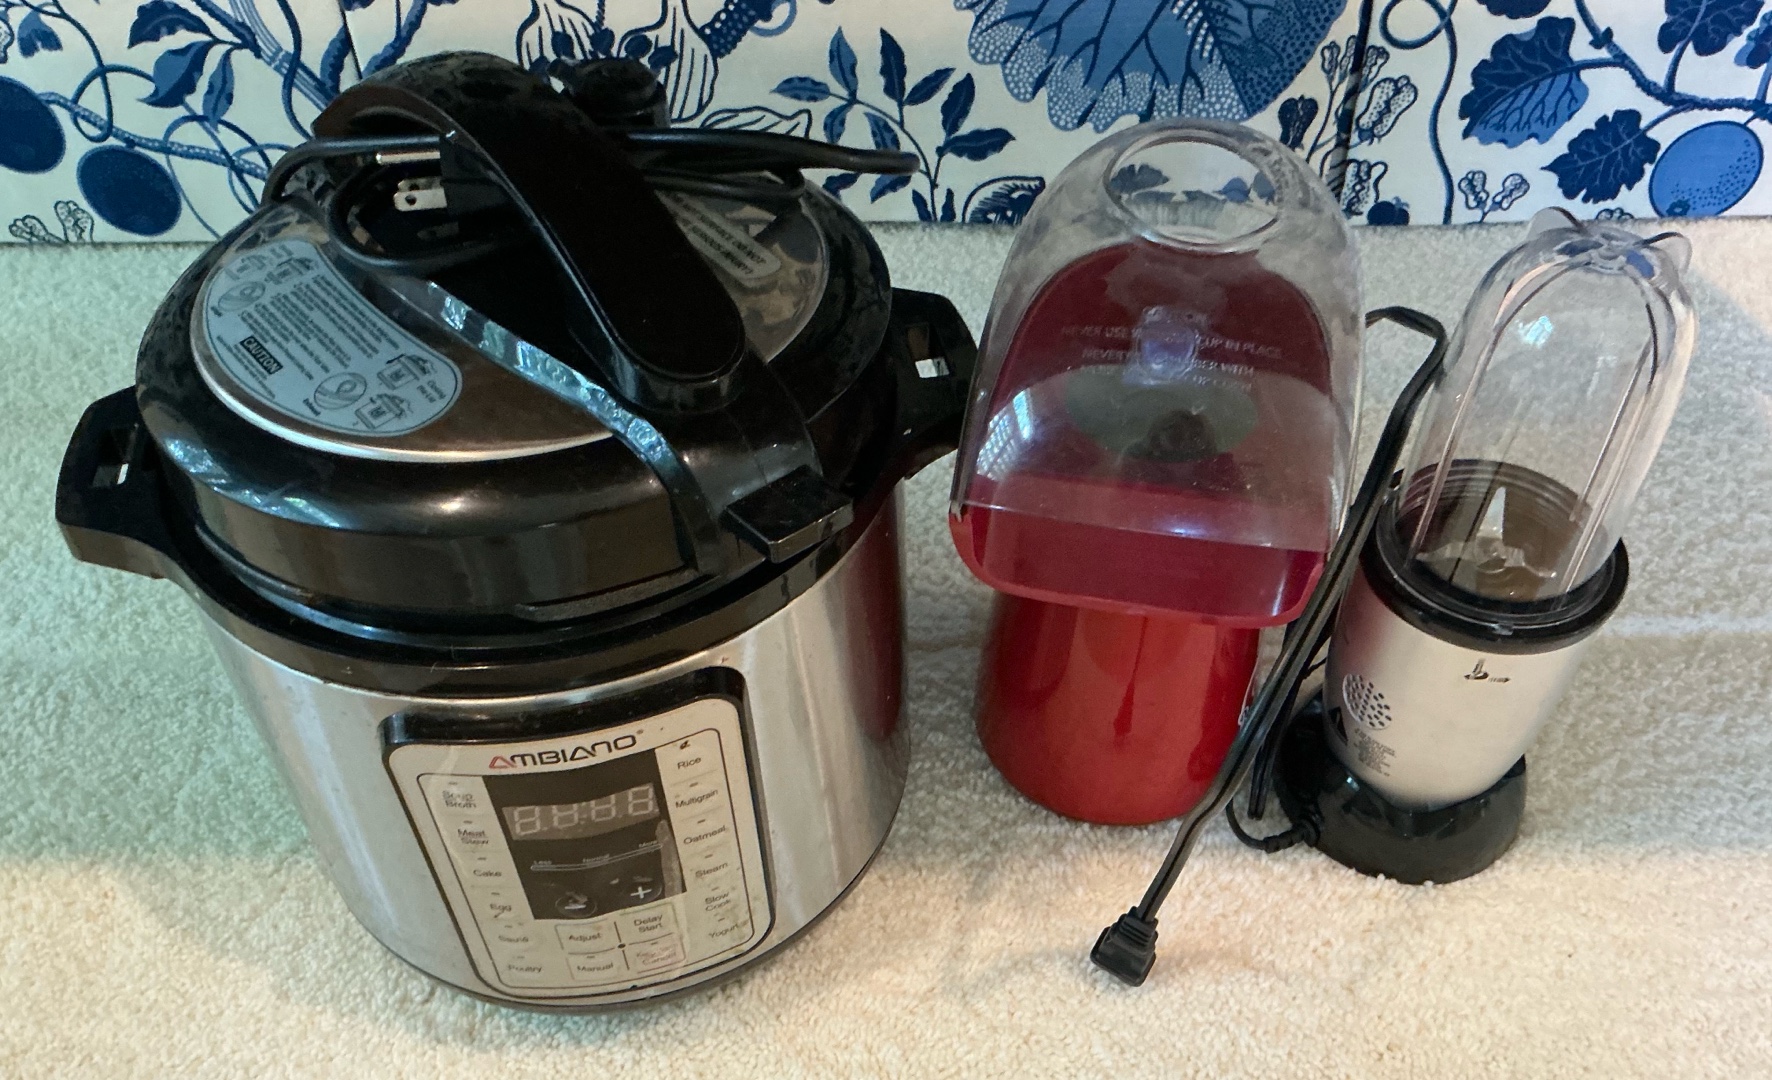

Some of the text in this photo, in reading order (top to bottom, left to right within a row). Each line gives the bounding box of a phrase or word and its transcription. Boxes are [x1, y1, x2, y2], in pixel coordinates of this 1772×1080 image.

[240, 337, 282, 374] CAUTION
[488, 734, 637, 769] AMBIANO
[677, 757, 702, 770] Rice
[675, 788, 719, 809] Multigrain
[683, 825, 726, 846] Oatmeal
[473, 868, 502, 878] Cake
[694, 861, 729, 879] Steam
[704, 890, 730, 905] Slow
[490, 902, 513, 913] Egg
[705, 899, 731, 913] Cook
[633, 914, 664, 927] Delay
[638, 921, 663, 933] Start
[568, 932, 602, 943] Adjust
[577, 962, 614, 972] Manual
